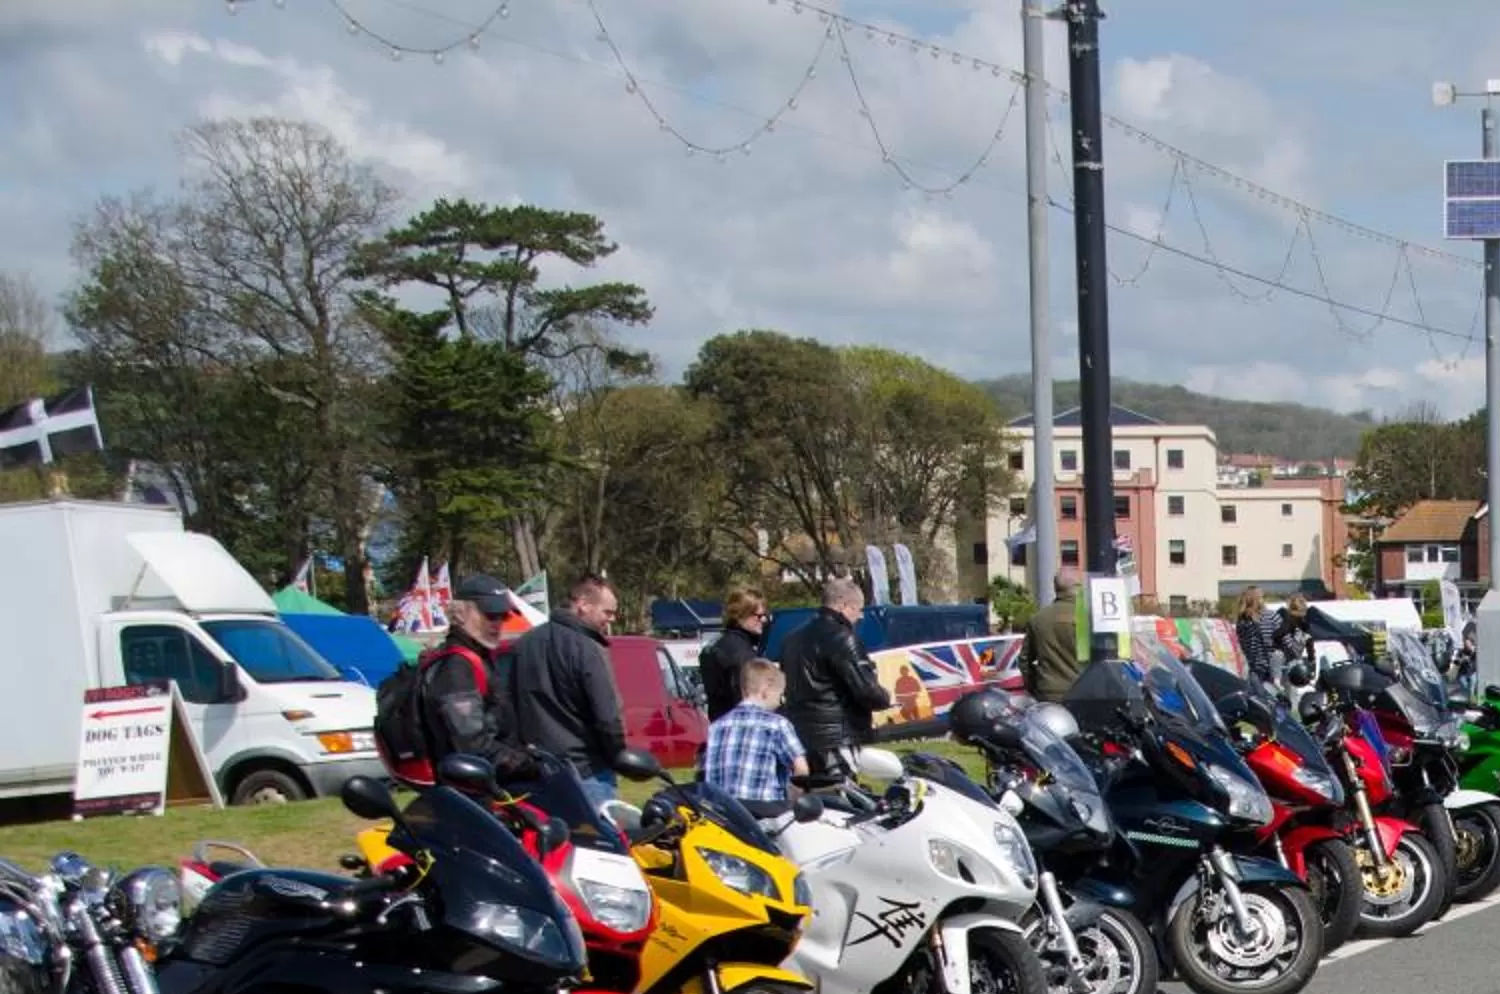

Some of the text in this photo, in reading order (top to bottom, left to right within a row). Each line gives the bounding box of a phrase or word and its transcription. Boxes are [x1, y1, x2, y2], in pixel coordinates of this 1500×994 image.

[1101, 591, 1118, 617] B
[85, 723, 165, 743] DOG TAGS
[845, 896, 925, 948] 隼
